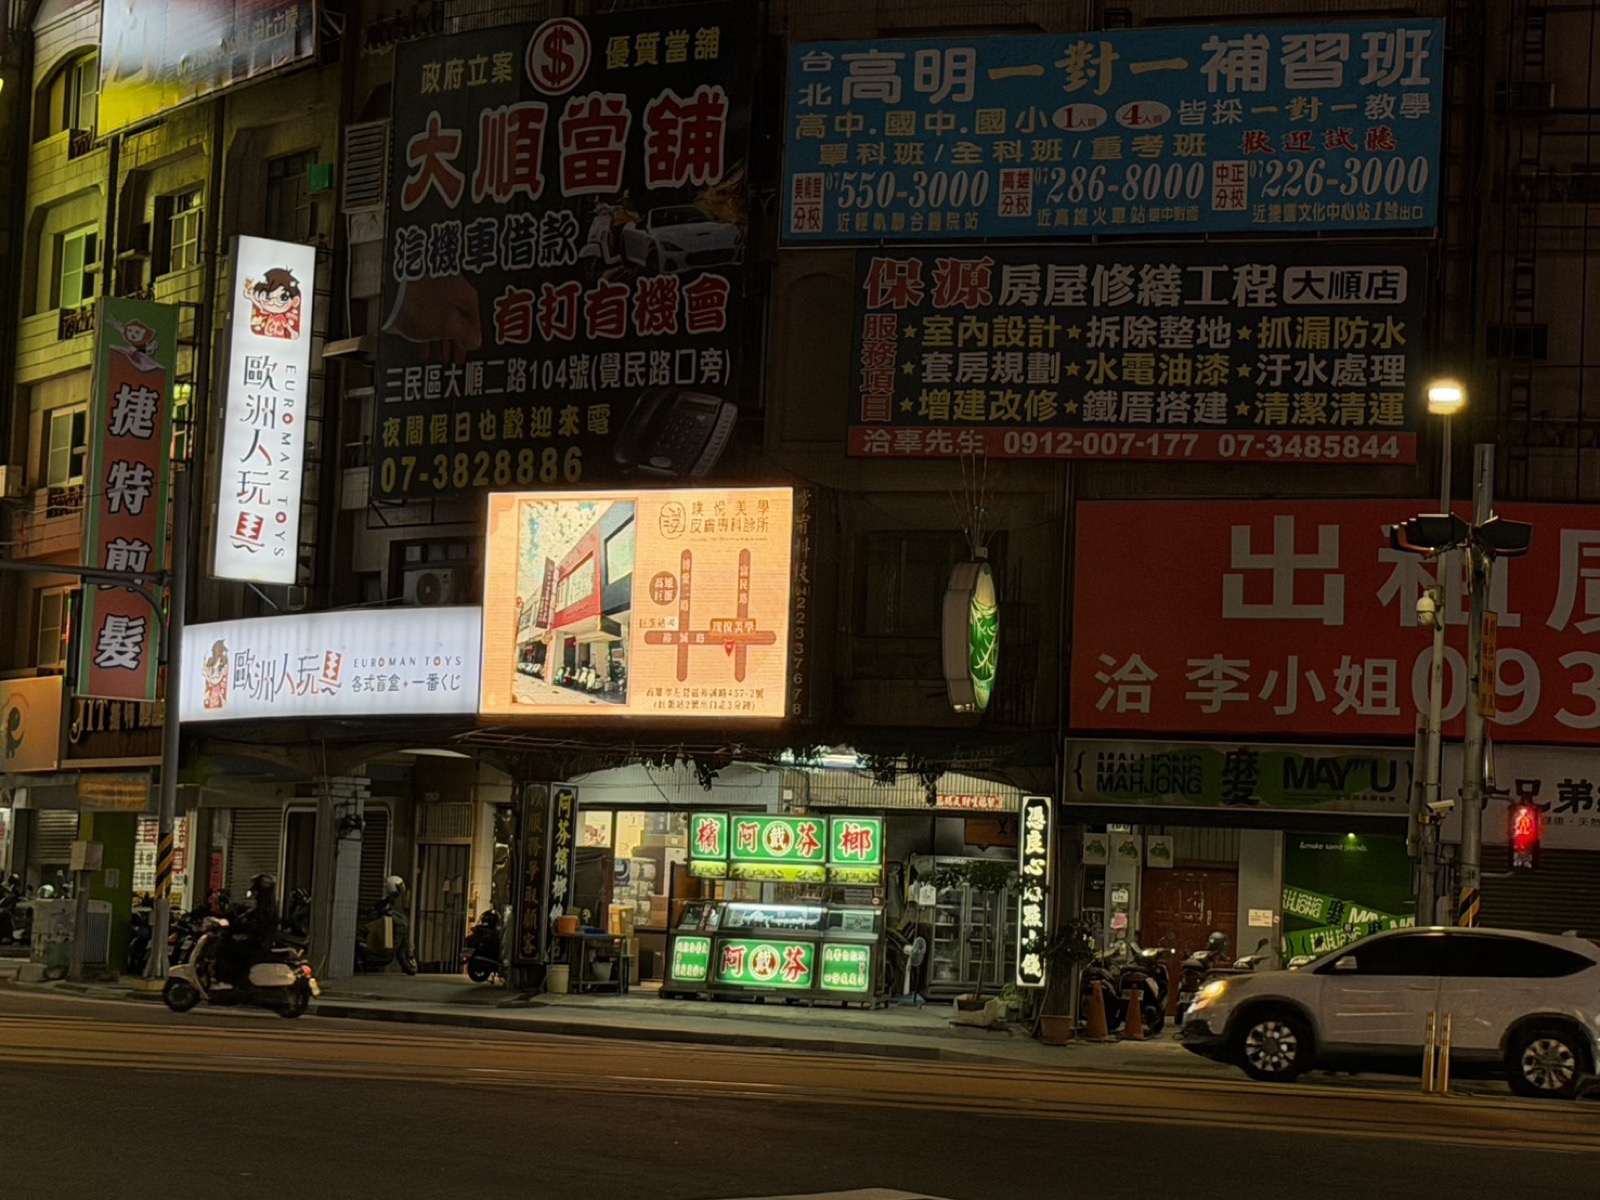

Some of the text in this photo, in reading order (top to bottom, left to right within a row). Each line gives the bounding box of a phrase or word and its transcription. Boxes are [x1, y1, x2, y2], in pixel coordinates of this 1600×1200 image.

[605, 26, 721, 70] 優質當舖
[840, 28, 1434, 105] 高明一對一補習班
[421, 51, 514, 94] 政府立案
[798, 50, 835, 107] 台北
[1178, 92, 1431, 127] 皆採一對一教學
[402, 84, 729, 210] 大順當舖
[1239, 126, 1397, 155] 歡迎試聽
[837, 169, 990, 209] 550-3000
[1001, 170, 1031, 190] 高雄
[1046, 162, 1206, 205] 286-8000
[1215, 163, 1246, 184] 中正
[1261, 155, 1429, 198] 226-3000
[793, 206, 821, 231] 分校
[1000, 194, 1030, 215] 分校
[1215, 188, 1245, 209] 分校
[395, 210, 579, 281] 汽機車借款
[863, 255, 1400, 310] 保源 房屋修繕工程 大順店
[494, 272, 731, 344] 有打有機會
[920, 314, 1408, 352] 室內設計 拆除整地 抓漏防水
[859, 313, 899, 423] 服務項目
[920, 351, 1061, 384] 套房規劃
[1083, 352, 1232, 388] 水電油漆
[382, 403, 611, 449] 夜間假日也歡迎來電
[917, 388, 1059, 423] 增建改修
[1252, 391, 1406, 426] 清潔清運
[229, 354, 281, 553] 歐洲人玩具
[273, 364, 297, 556] EUROMAN TOYS
[1002, 430, 1200, 456] 0912-007-177
[1217, 434, 1399, 460] 07-3485844
[380, 446, 584, 494] 07-3828886
[232, 649, 343, 702] 歐洲人玩具
[353, 655, 463, 669] EUROMAN TOYS
[1095, 653, 1158, 714] 洽
[1184, 653, 1400, 717] 李小姐
[1096, 774, 1203, 794] MAHJONG
[697, 819, 722, 855] 檳
[840, 821, 872, 860] 榔
